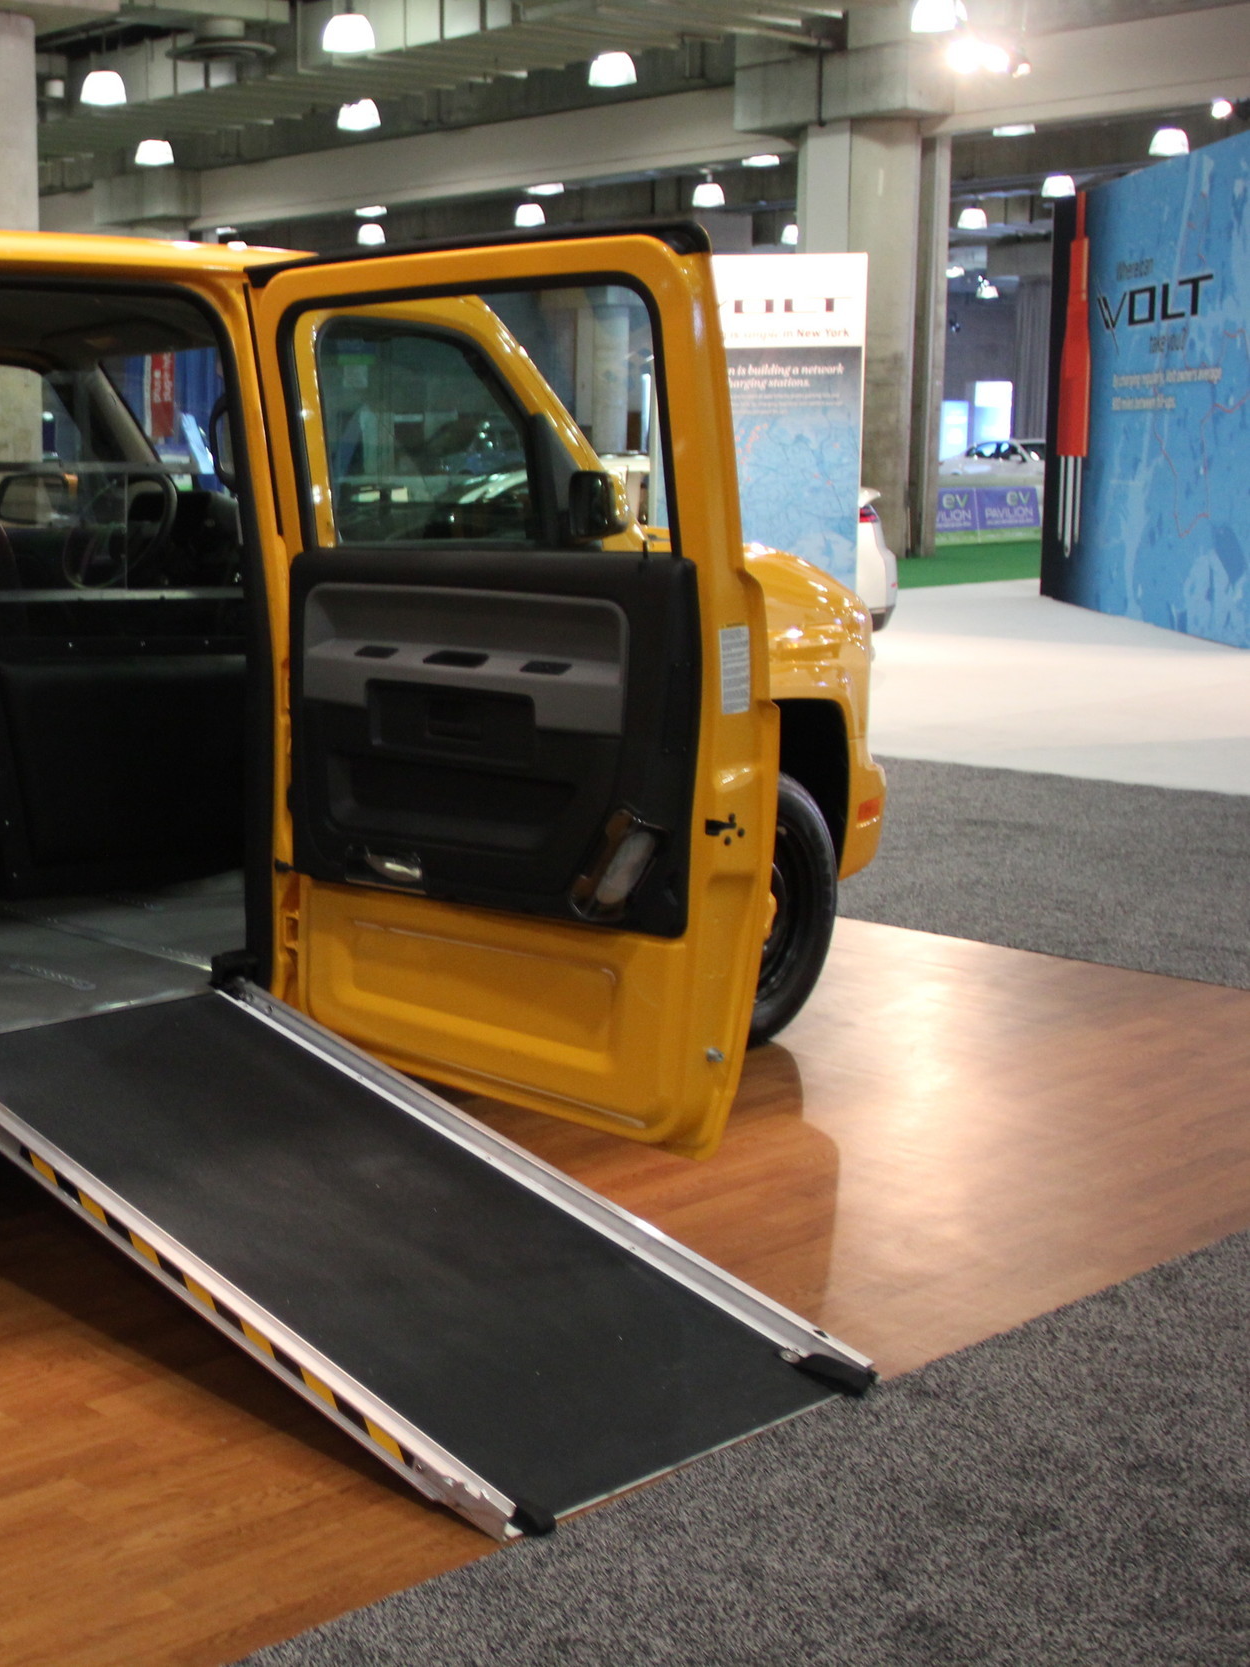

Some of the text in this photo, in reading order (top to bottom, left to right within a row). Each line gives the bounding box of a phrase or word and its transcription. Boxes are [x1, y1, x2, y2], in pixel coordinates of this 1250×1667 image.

[1097, 273, 1213, 329] VOLT
[796, 328, 820, 338] New
[825, 327, 849, 338] York
[737, 365, 746, 376] is
[748, 363, 791, 377] building
[792, 367, 799, 375] a
[801, 363, 845, 375] network
[728, 377, 768, 391] harging
[985, 506, 1034, 519] PAVILION
